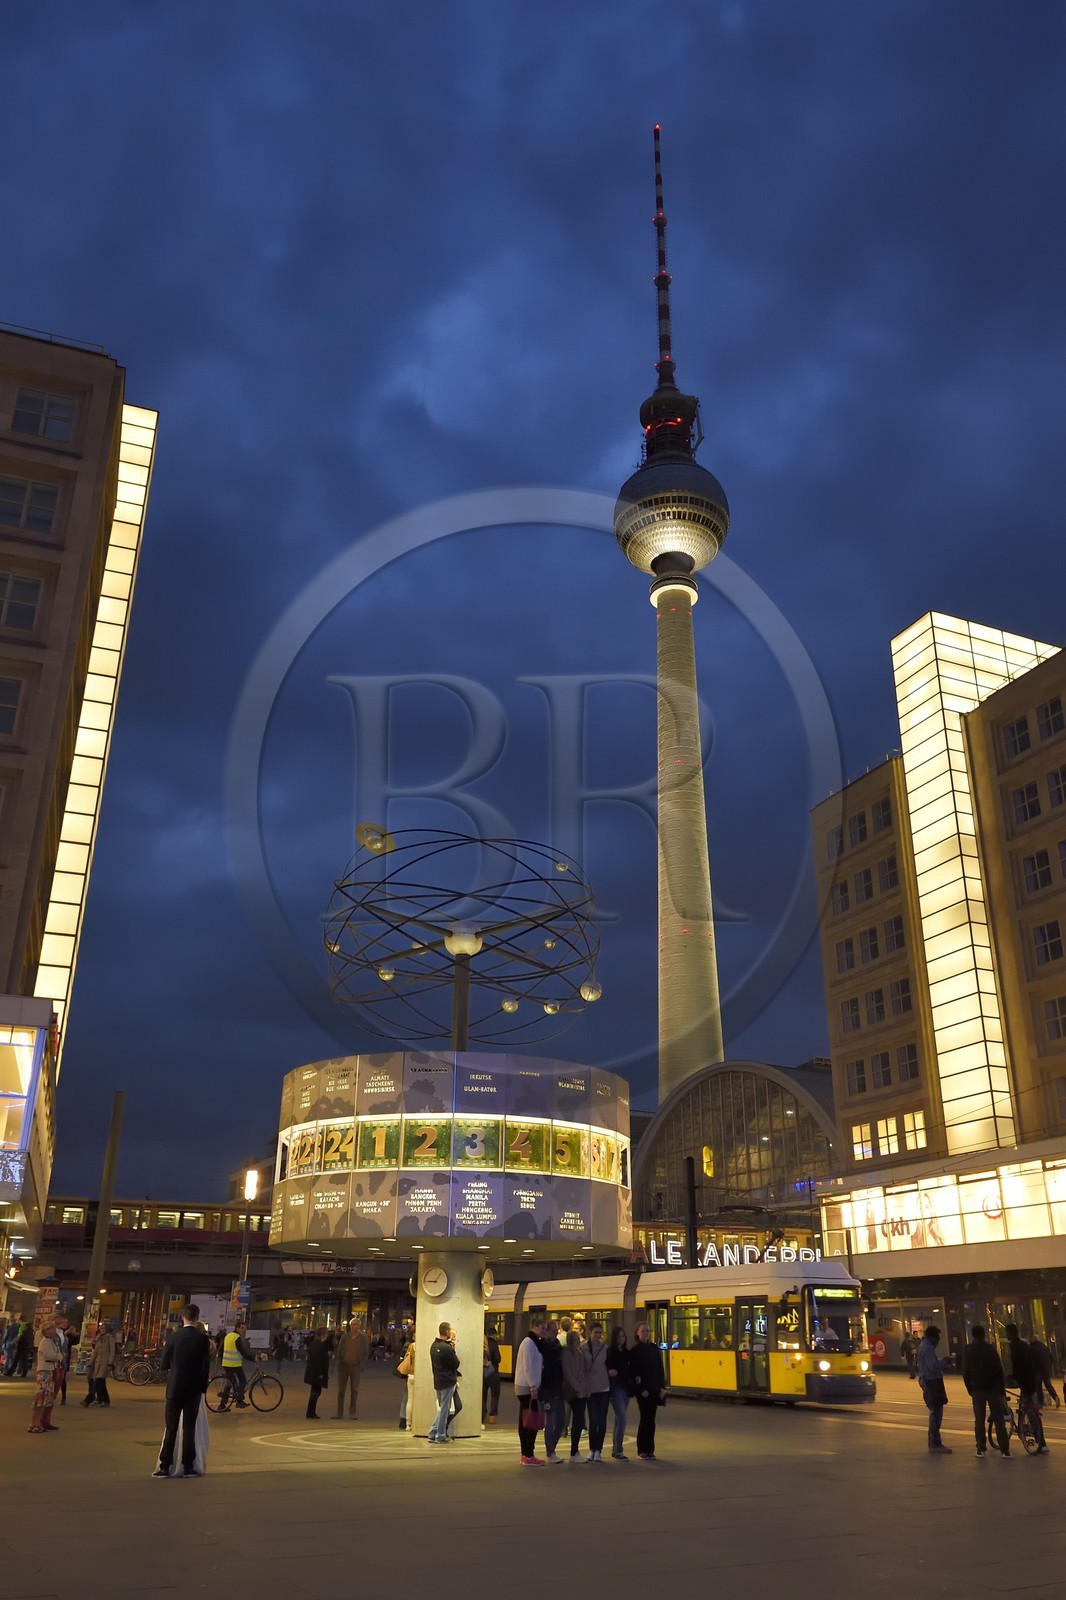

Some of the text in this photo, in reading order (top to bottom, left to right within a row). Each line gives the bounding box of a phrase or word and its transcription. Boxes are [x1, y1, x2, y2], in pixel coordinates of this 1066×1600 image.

[325, 1130, 356, 1160] 24
[372, 1127, 387, 1157] 1
[414, 1127, 438, 1157] 2
[465, 1128, 486, 1158] 3
[510, 1130, 532, 1160] 4
[556, 1134, 572, 1165] 5
